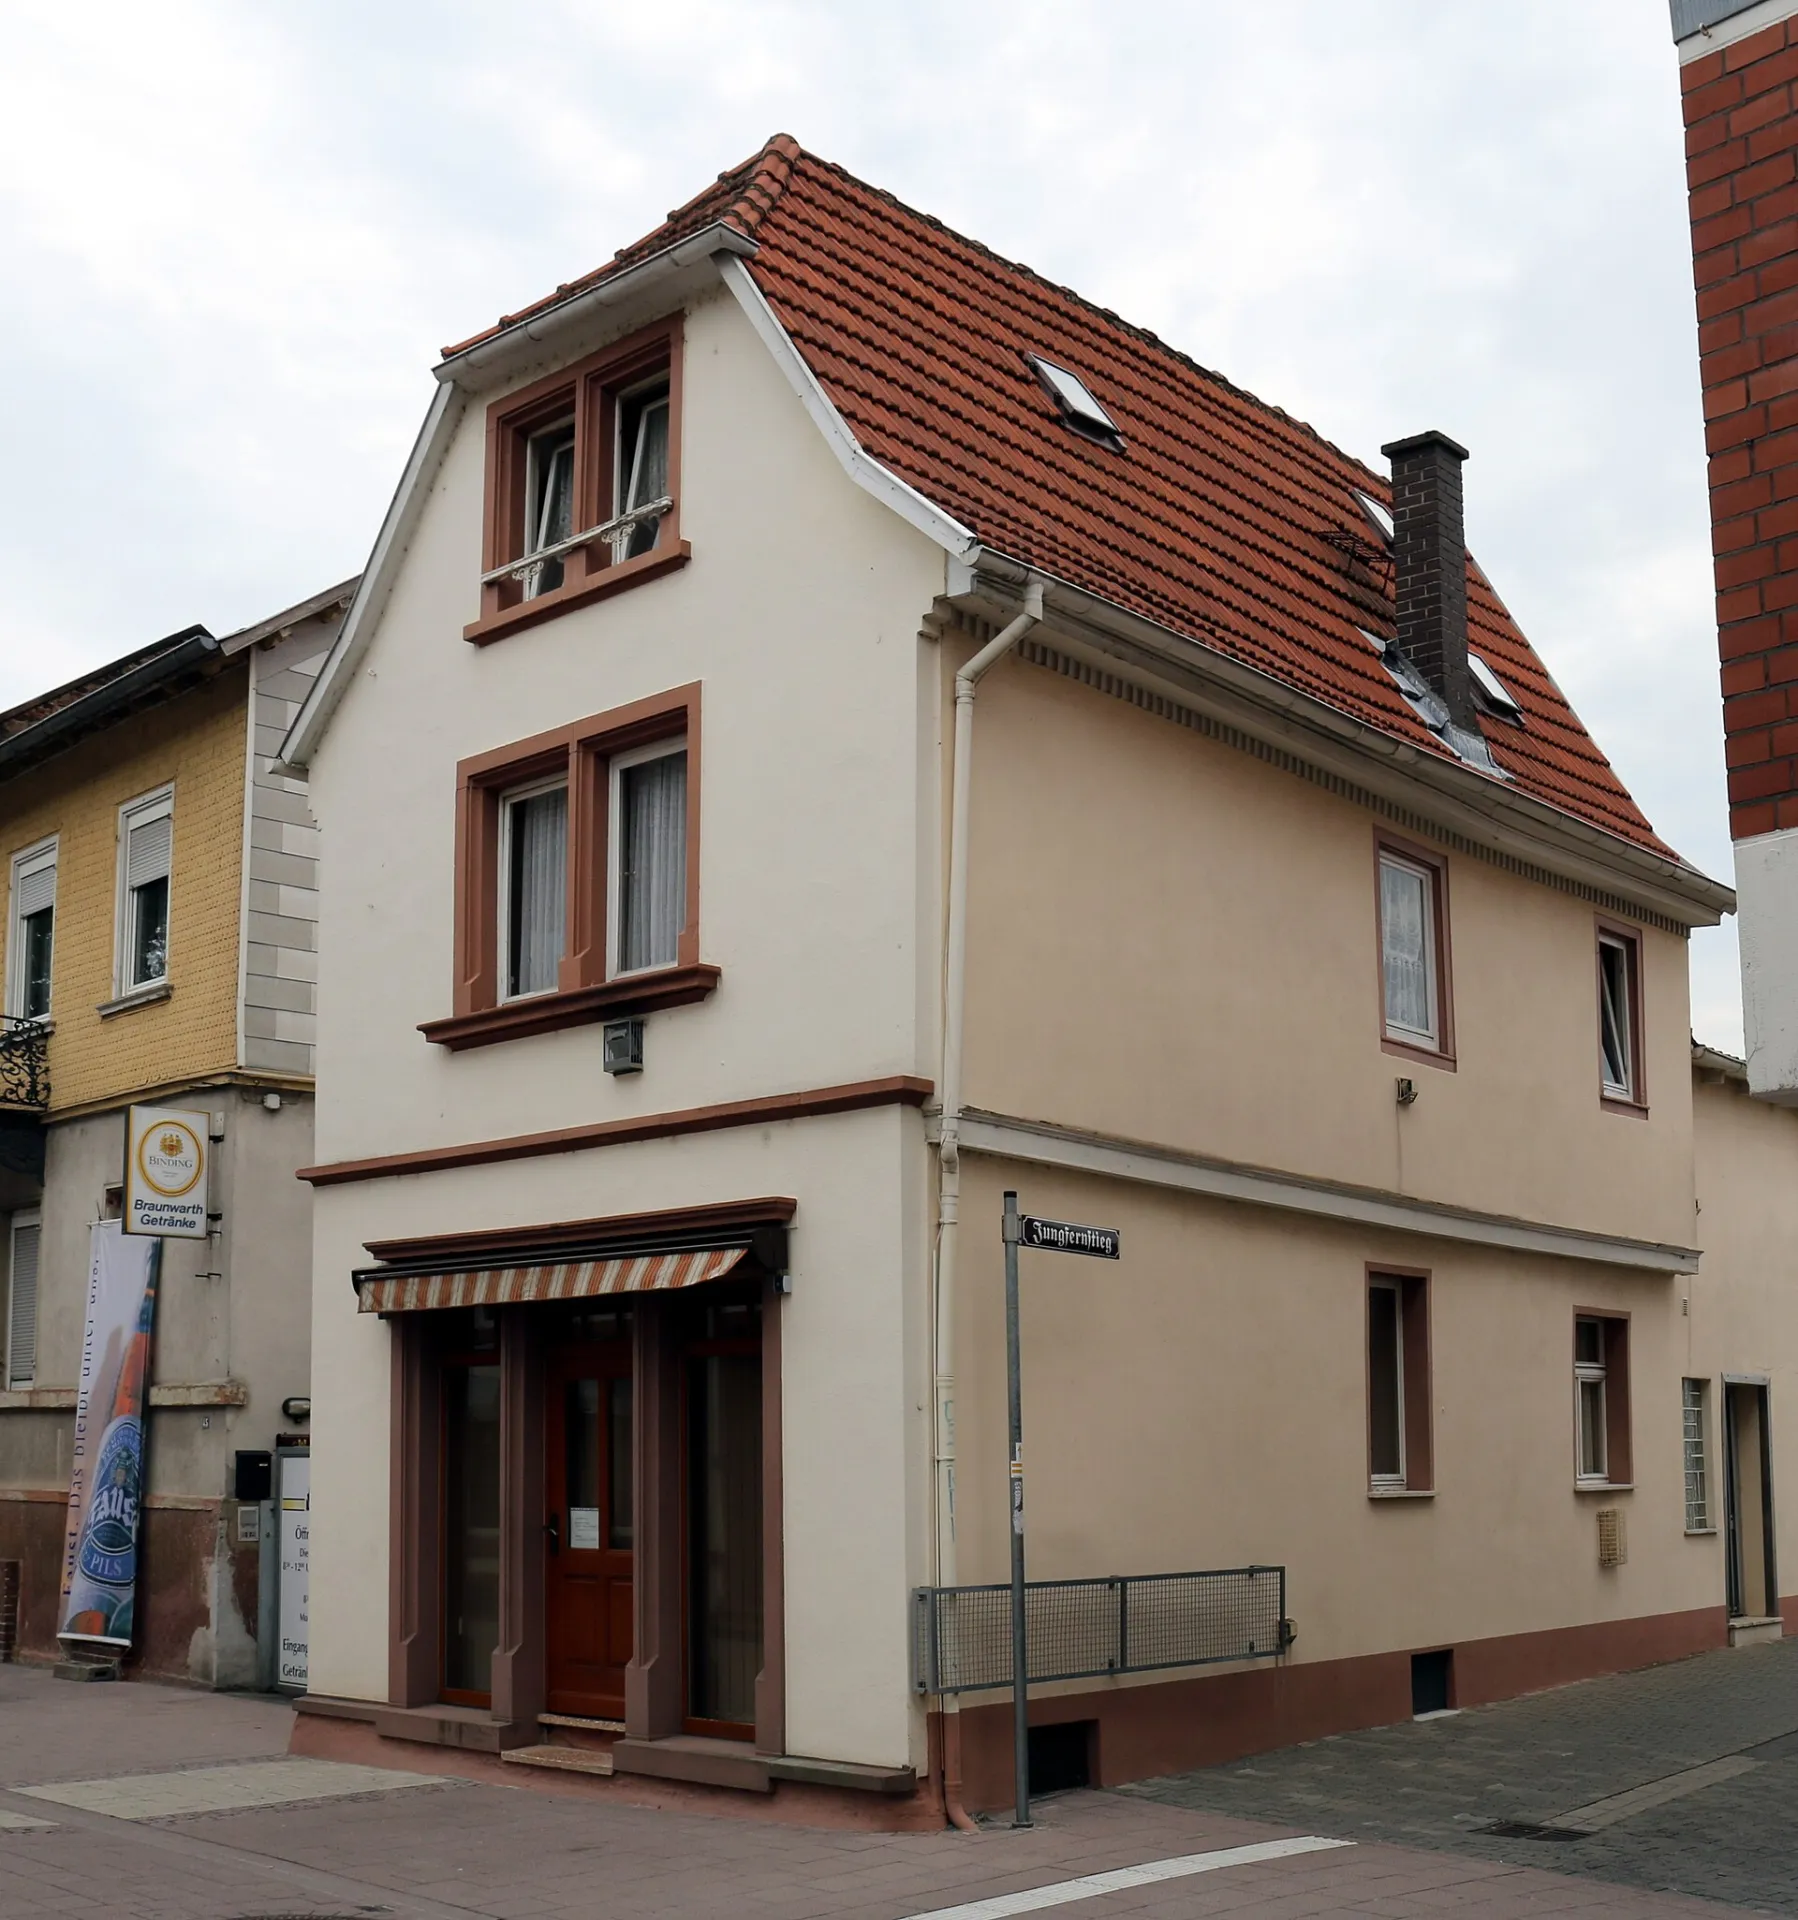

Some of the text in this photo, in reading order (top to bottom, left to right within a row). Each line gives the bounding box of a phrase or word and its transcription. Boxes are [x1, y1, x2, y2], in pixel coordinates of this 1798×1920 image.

[149, 1156, 193, 1168] BINDING
[134, 1199, 203, 1215] Braunwarth
[140, 1214, 196, 1229] Getränke
[90, 1552, 122, 1577] PILS
